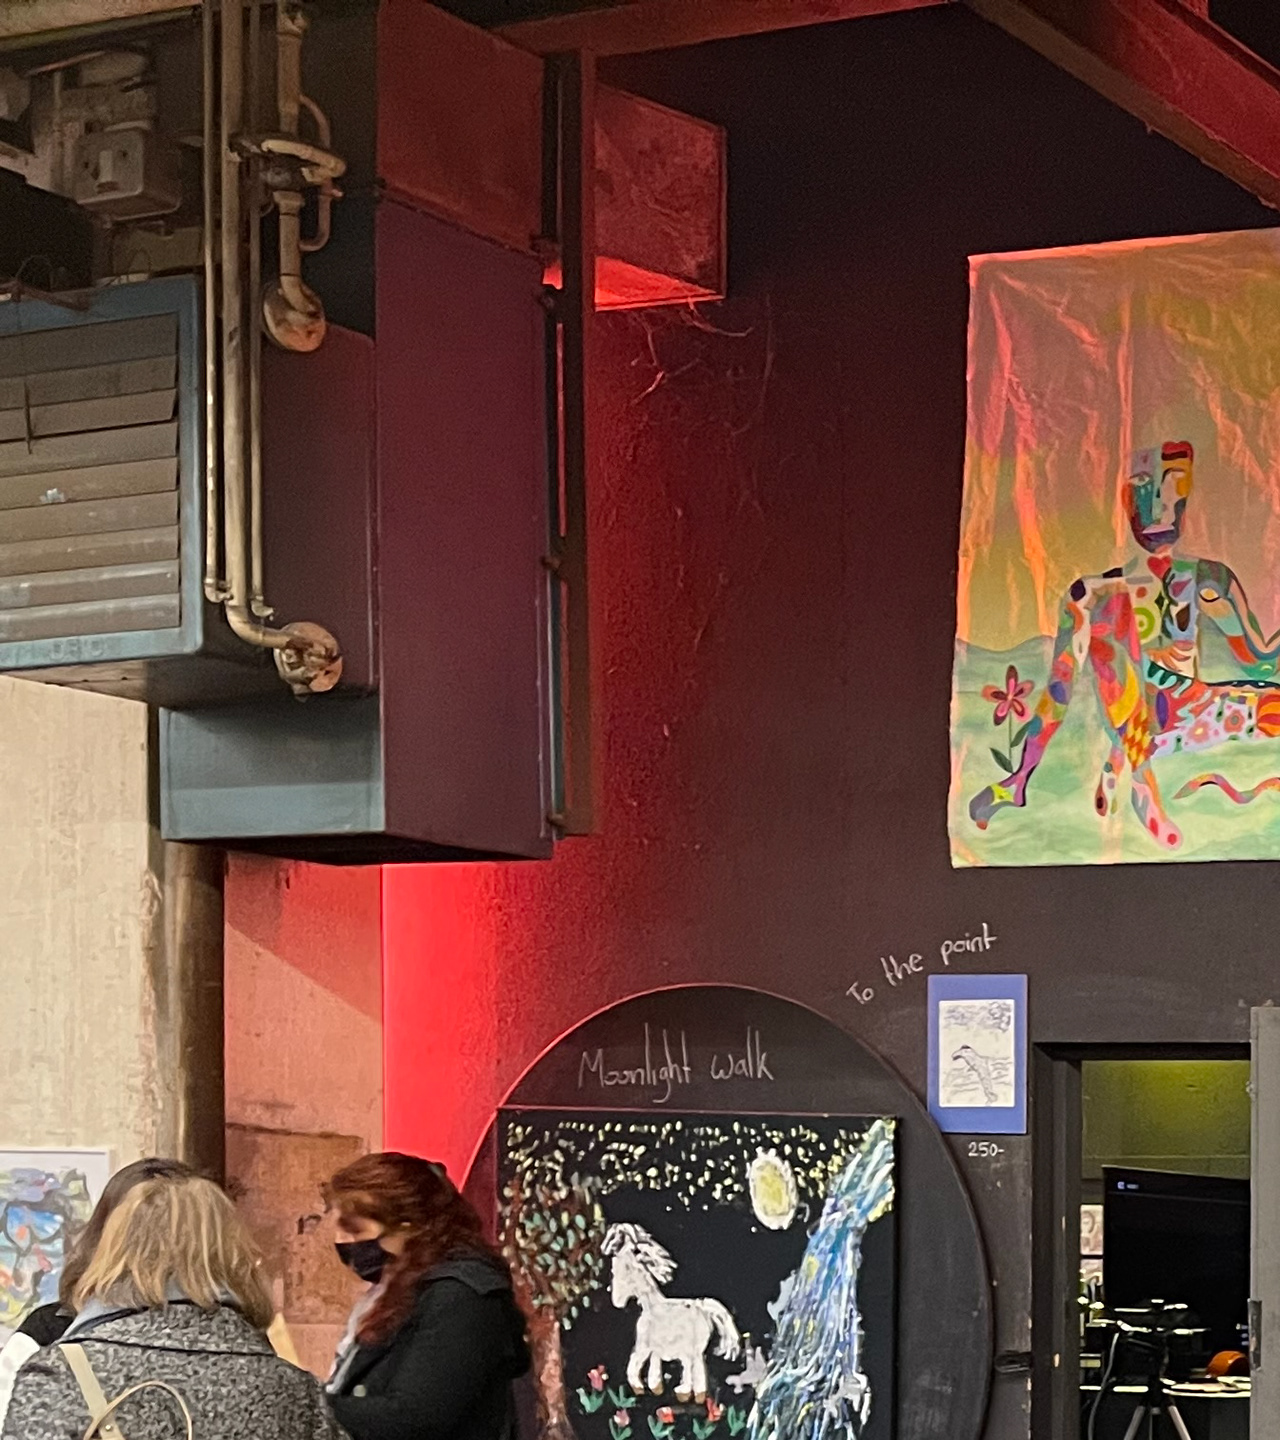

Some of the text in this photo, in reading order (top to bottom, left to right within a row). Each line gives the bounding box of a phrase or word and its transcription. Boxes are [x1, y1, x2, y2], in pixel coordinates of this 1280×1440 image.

[845, 921, 998, 1005] To the point
[578, 1021, 692, 1104] Moonlight
